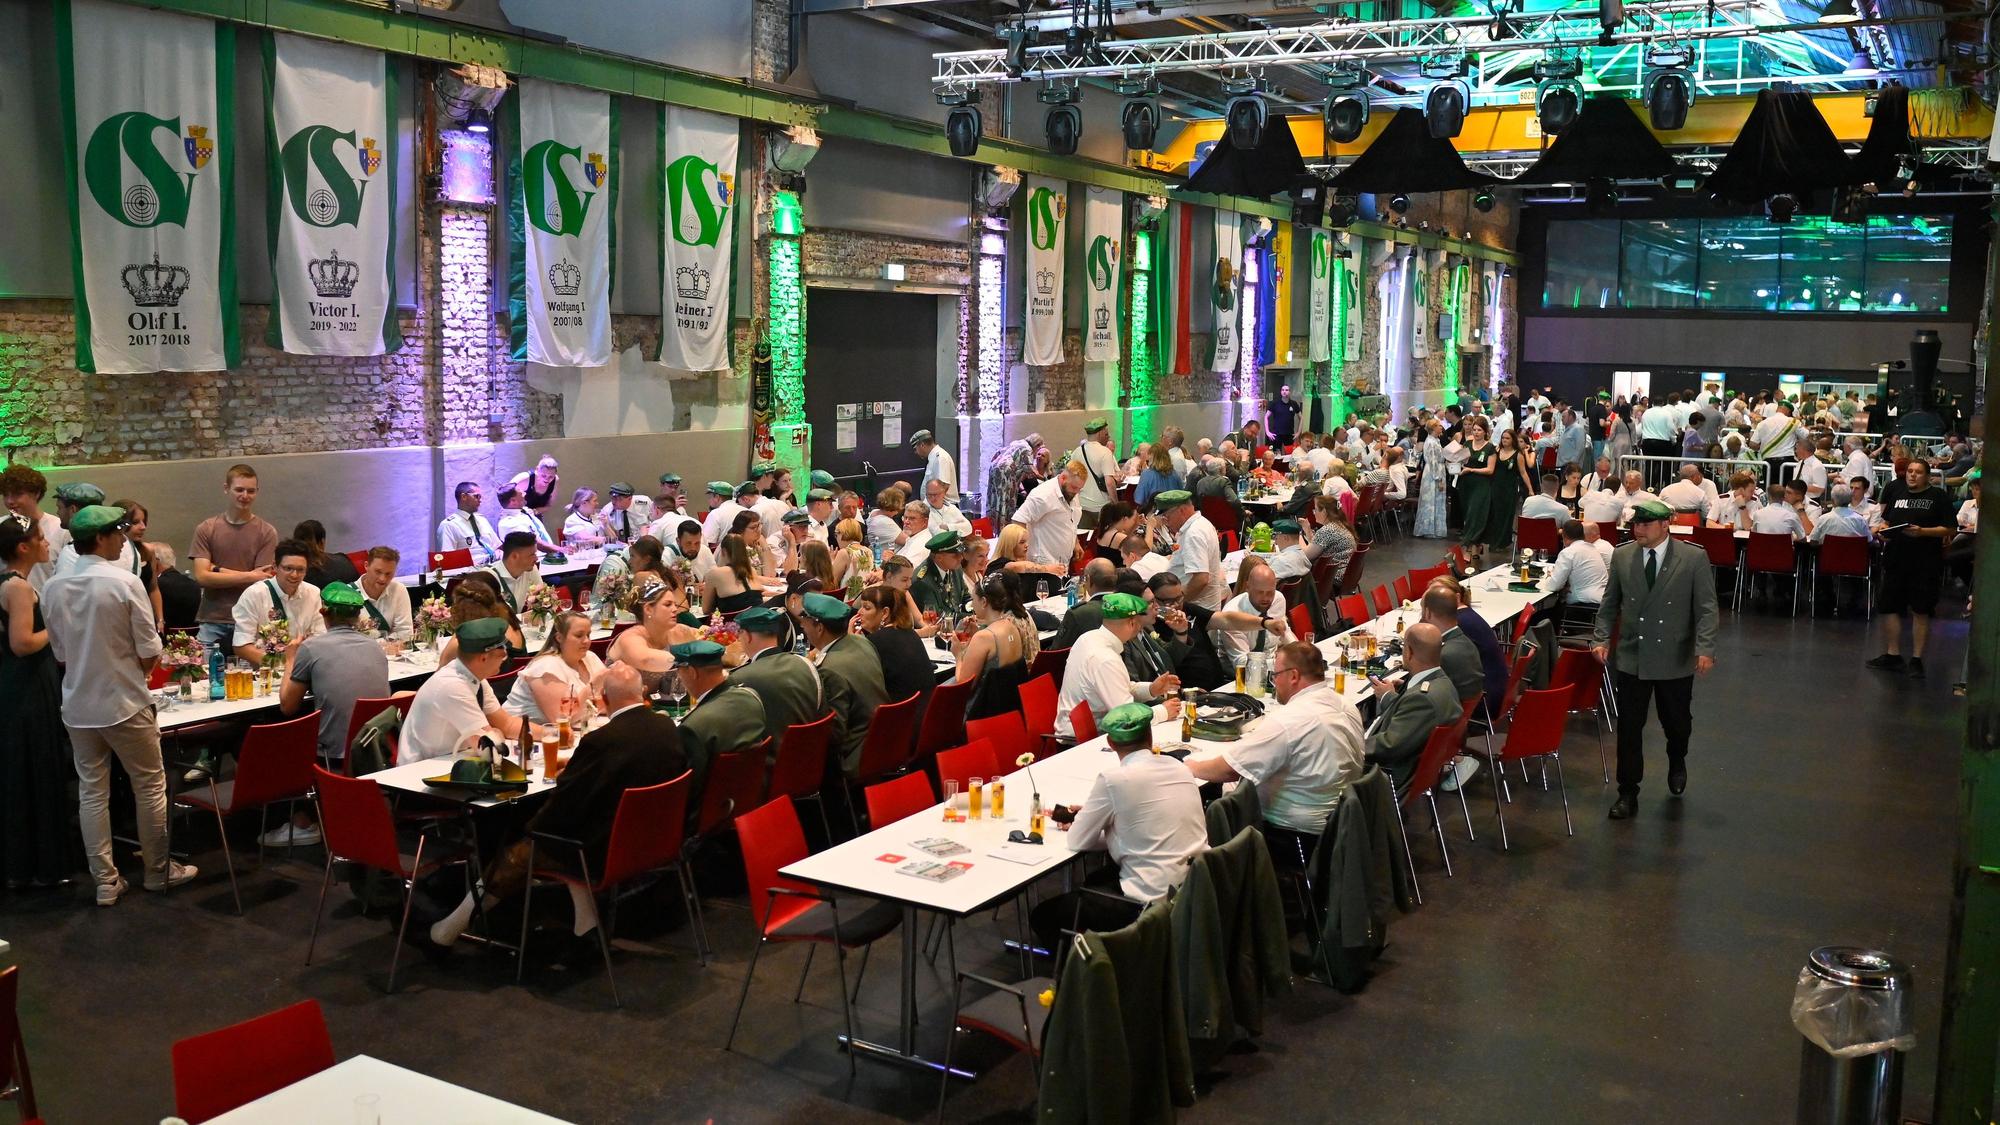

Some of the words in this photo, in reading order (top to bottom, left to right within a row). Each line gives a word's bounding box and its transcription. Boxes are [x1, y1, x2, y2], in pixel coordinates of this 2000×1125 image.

[308, 301, 348, 318] Victor
[351, 303, 360, 318] I.
[547, 301, 580, 313] Wolfgang
[172, 312, 187, 330] I.
[310, 321, 331, 331] 2019
[339, 321, 357, 332] 2022
[128, 334, 157, 346] 2017
[161, 334, 190, 346] 2018
[1894, 499, 1933, 510] VOLBEAT
